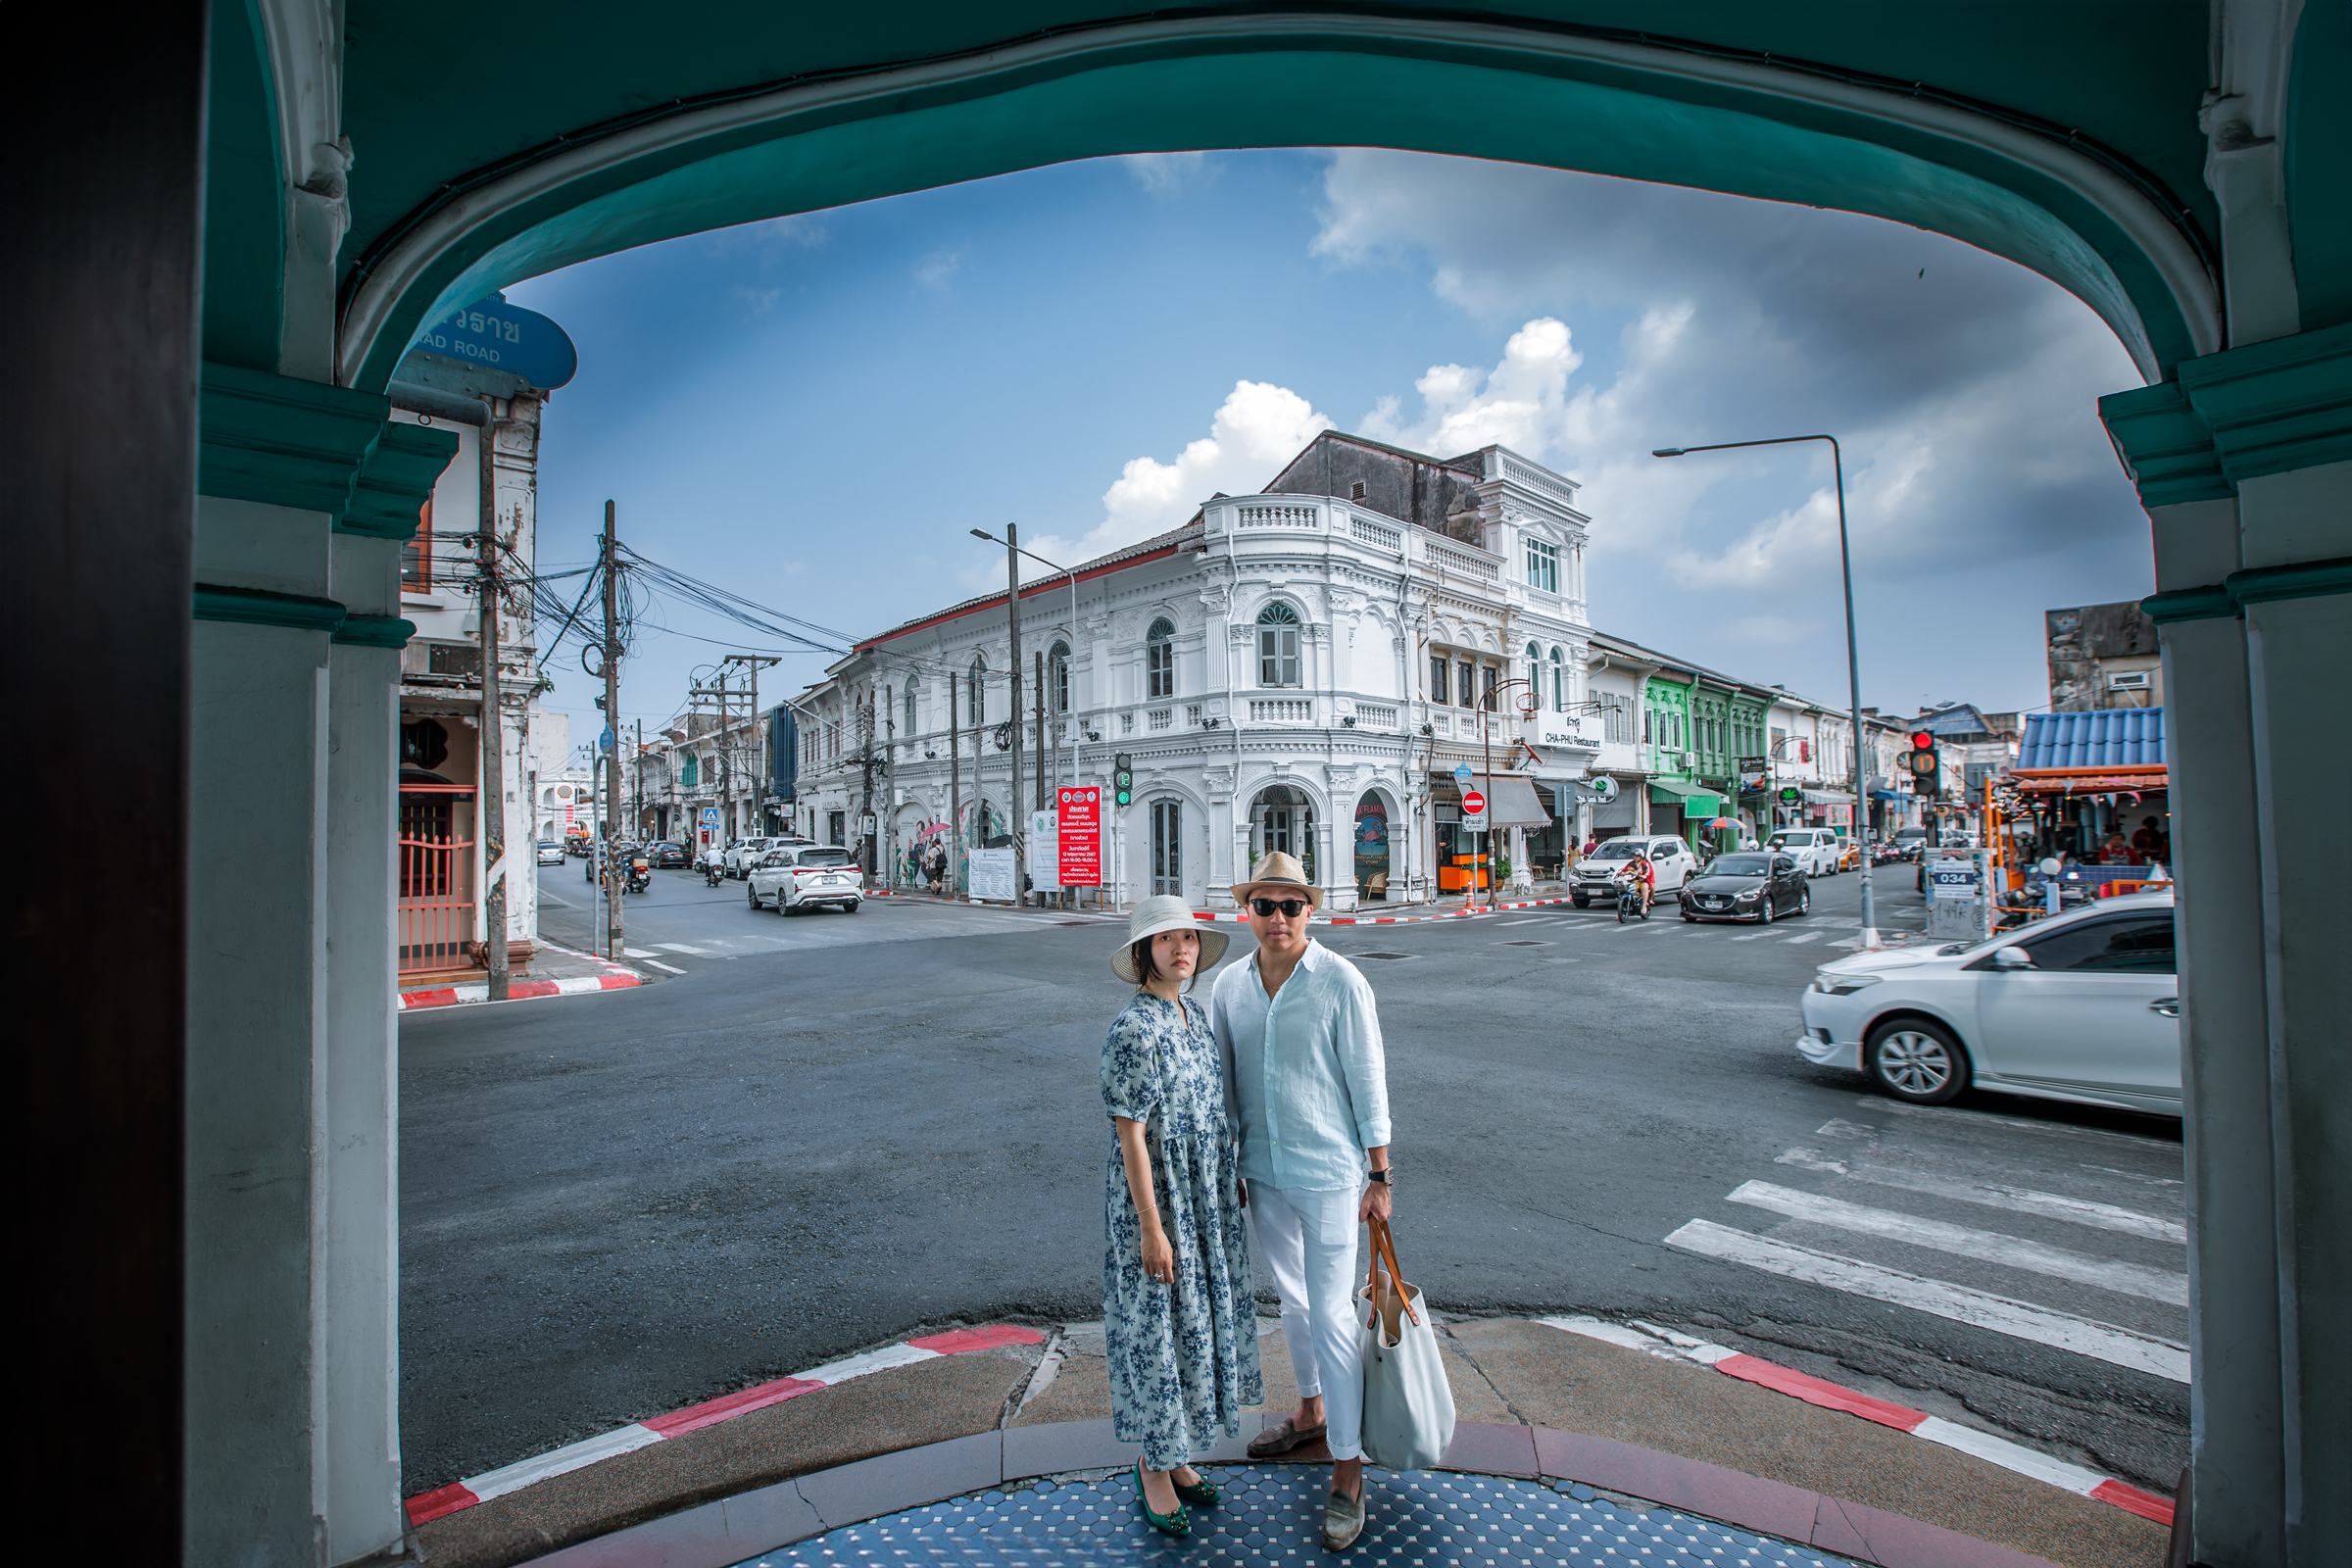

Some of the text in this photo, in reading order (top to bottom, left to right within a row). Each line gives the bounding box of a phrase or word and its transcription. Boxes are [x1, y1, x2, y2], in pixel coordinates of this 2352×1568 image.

[443, 309, 520, 344] วราช
[454, 339, 501, 363] ROAD
[1545, 733, 1600, 748] CHA-PHU Restaurant
[1920, 755, 1935, 770] 17
[1121, 773, 1130, 786] 12
[1940, 873, 1967, 883] 034
